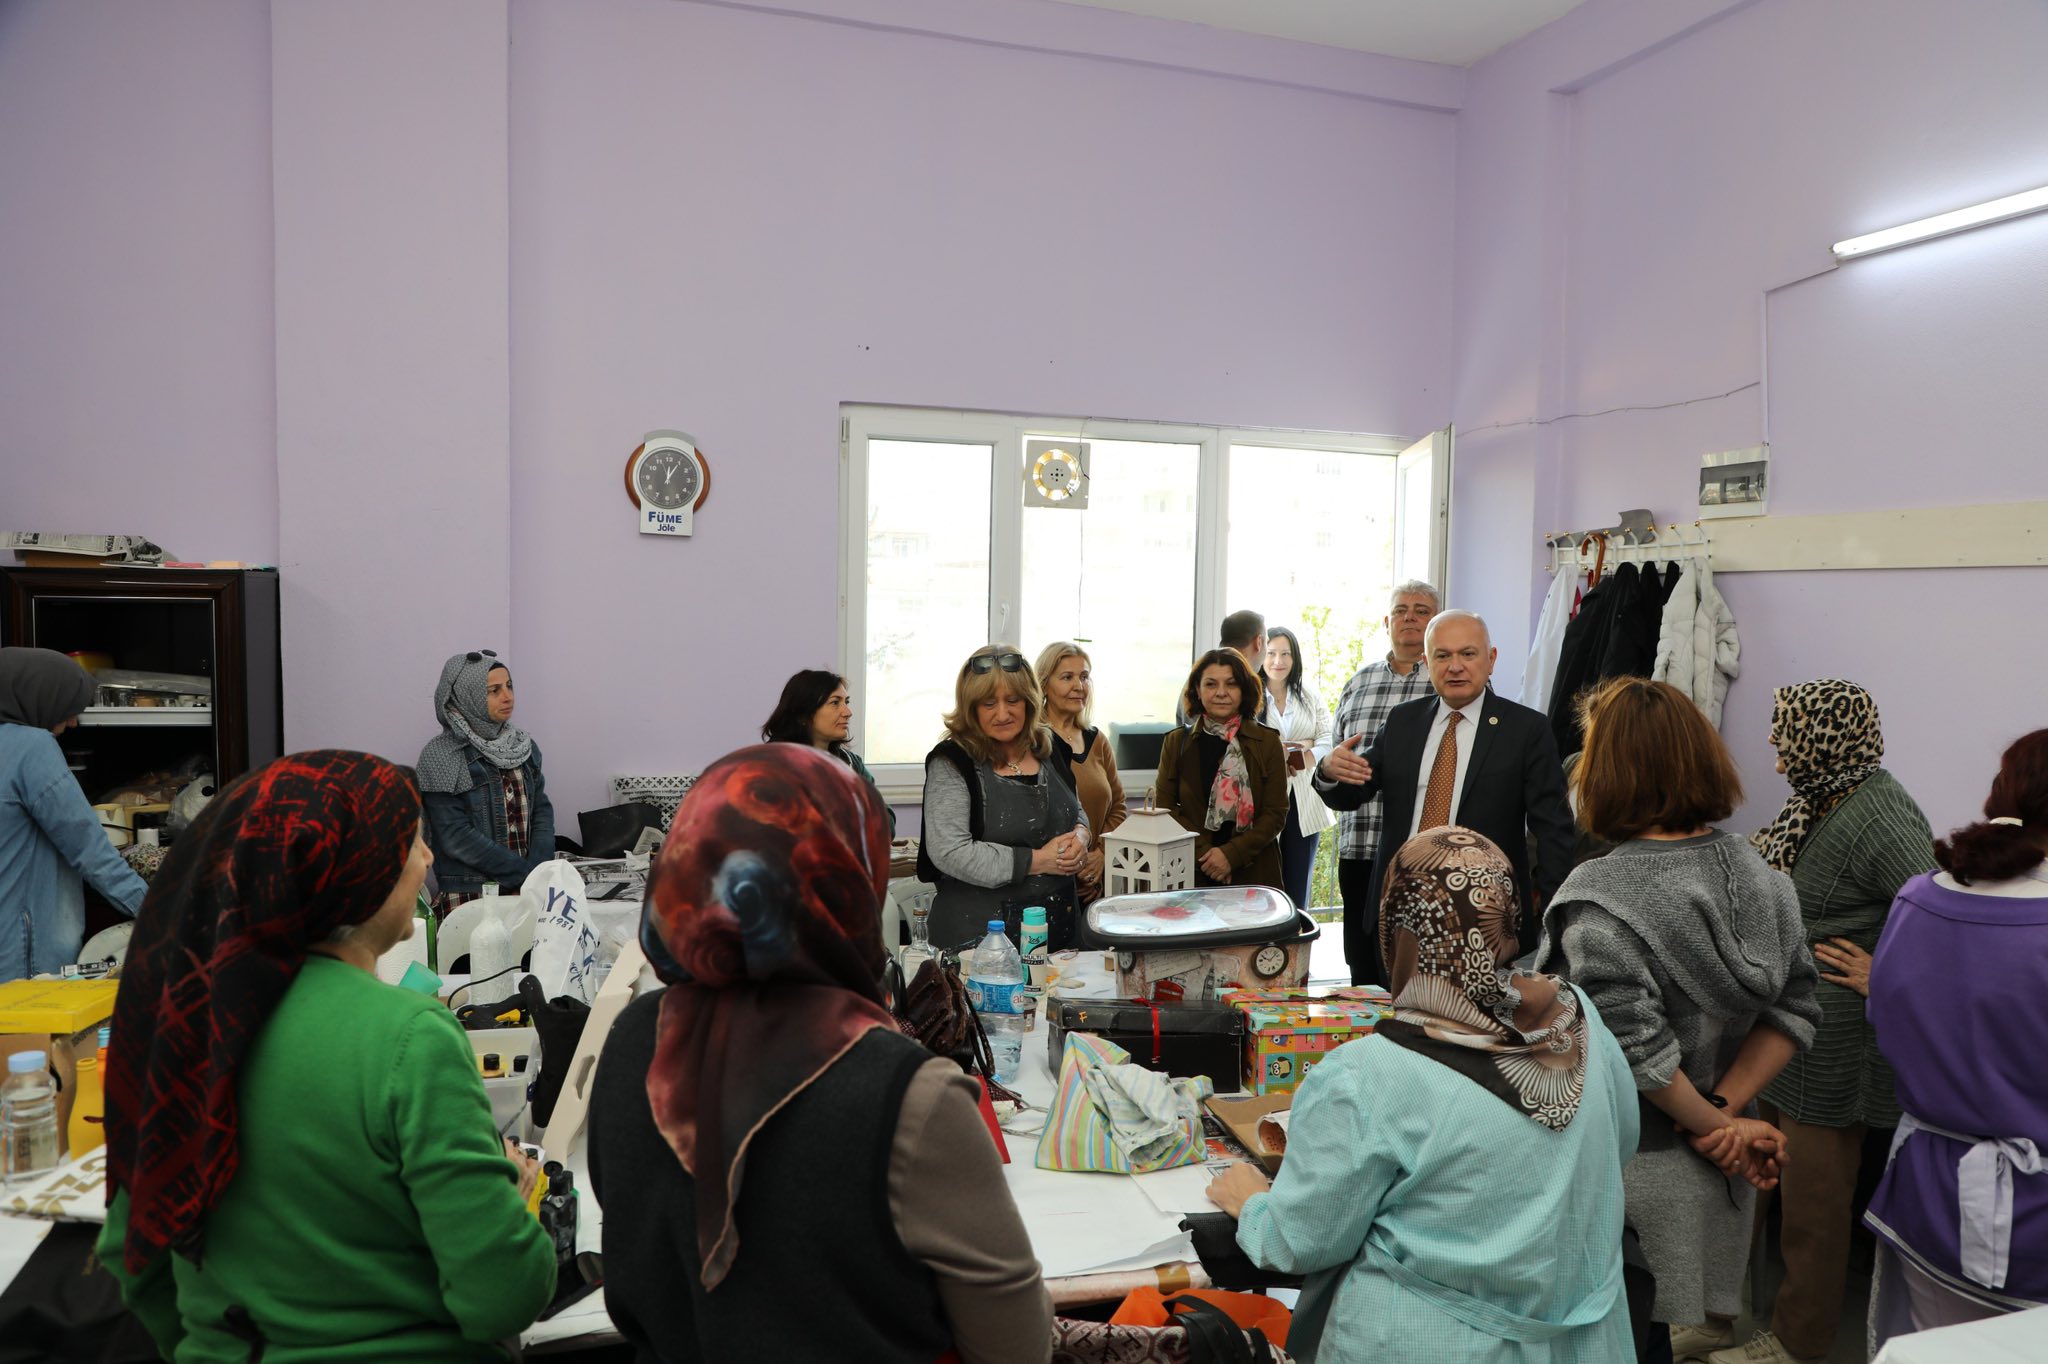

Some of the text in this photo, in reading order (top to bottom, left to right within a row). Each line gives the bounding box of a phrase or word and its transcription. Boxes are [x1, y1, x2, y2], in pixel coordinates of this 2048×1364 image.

[648, 511, 682, 523] FÜME
[657, 523, 676, 532] Jöle
[549, 916, 574, 931] 1981
